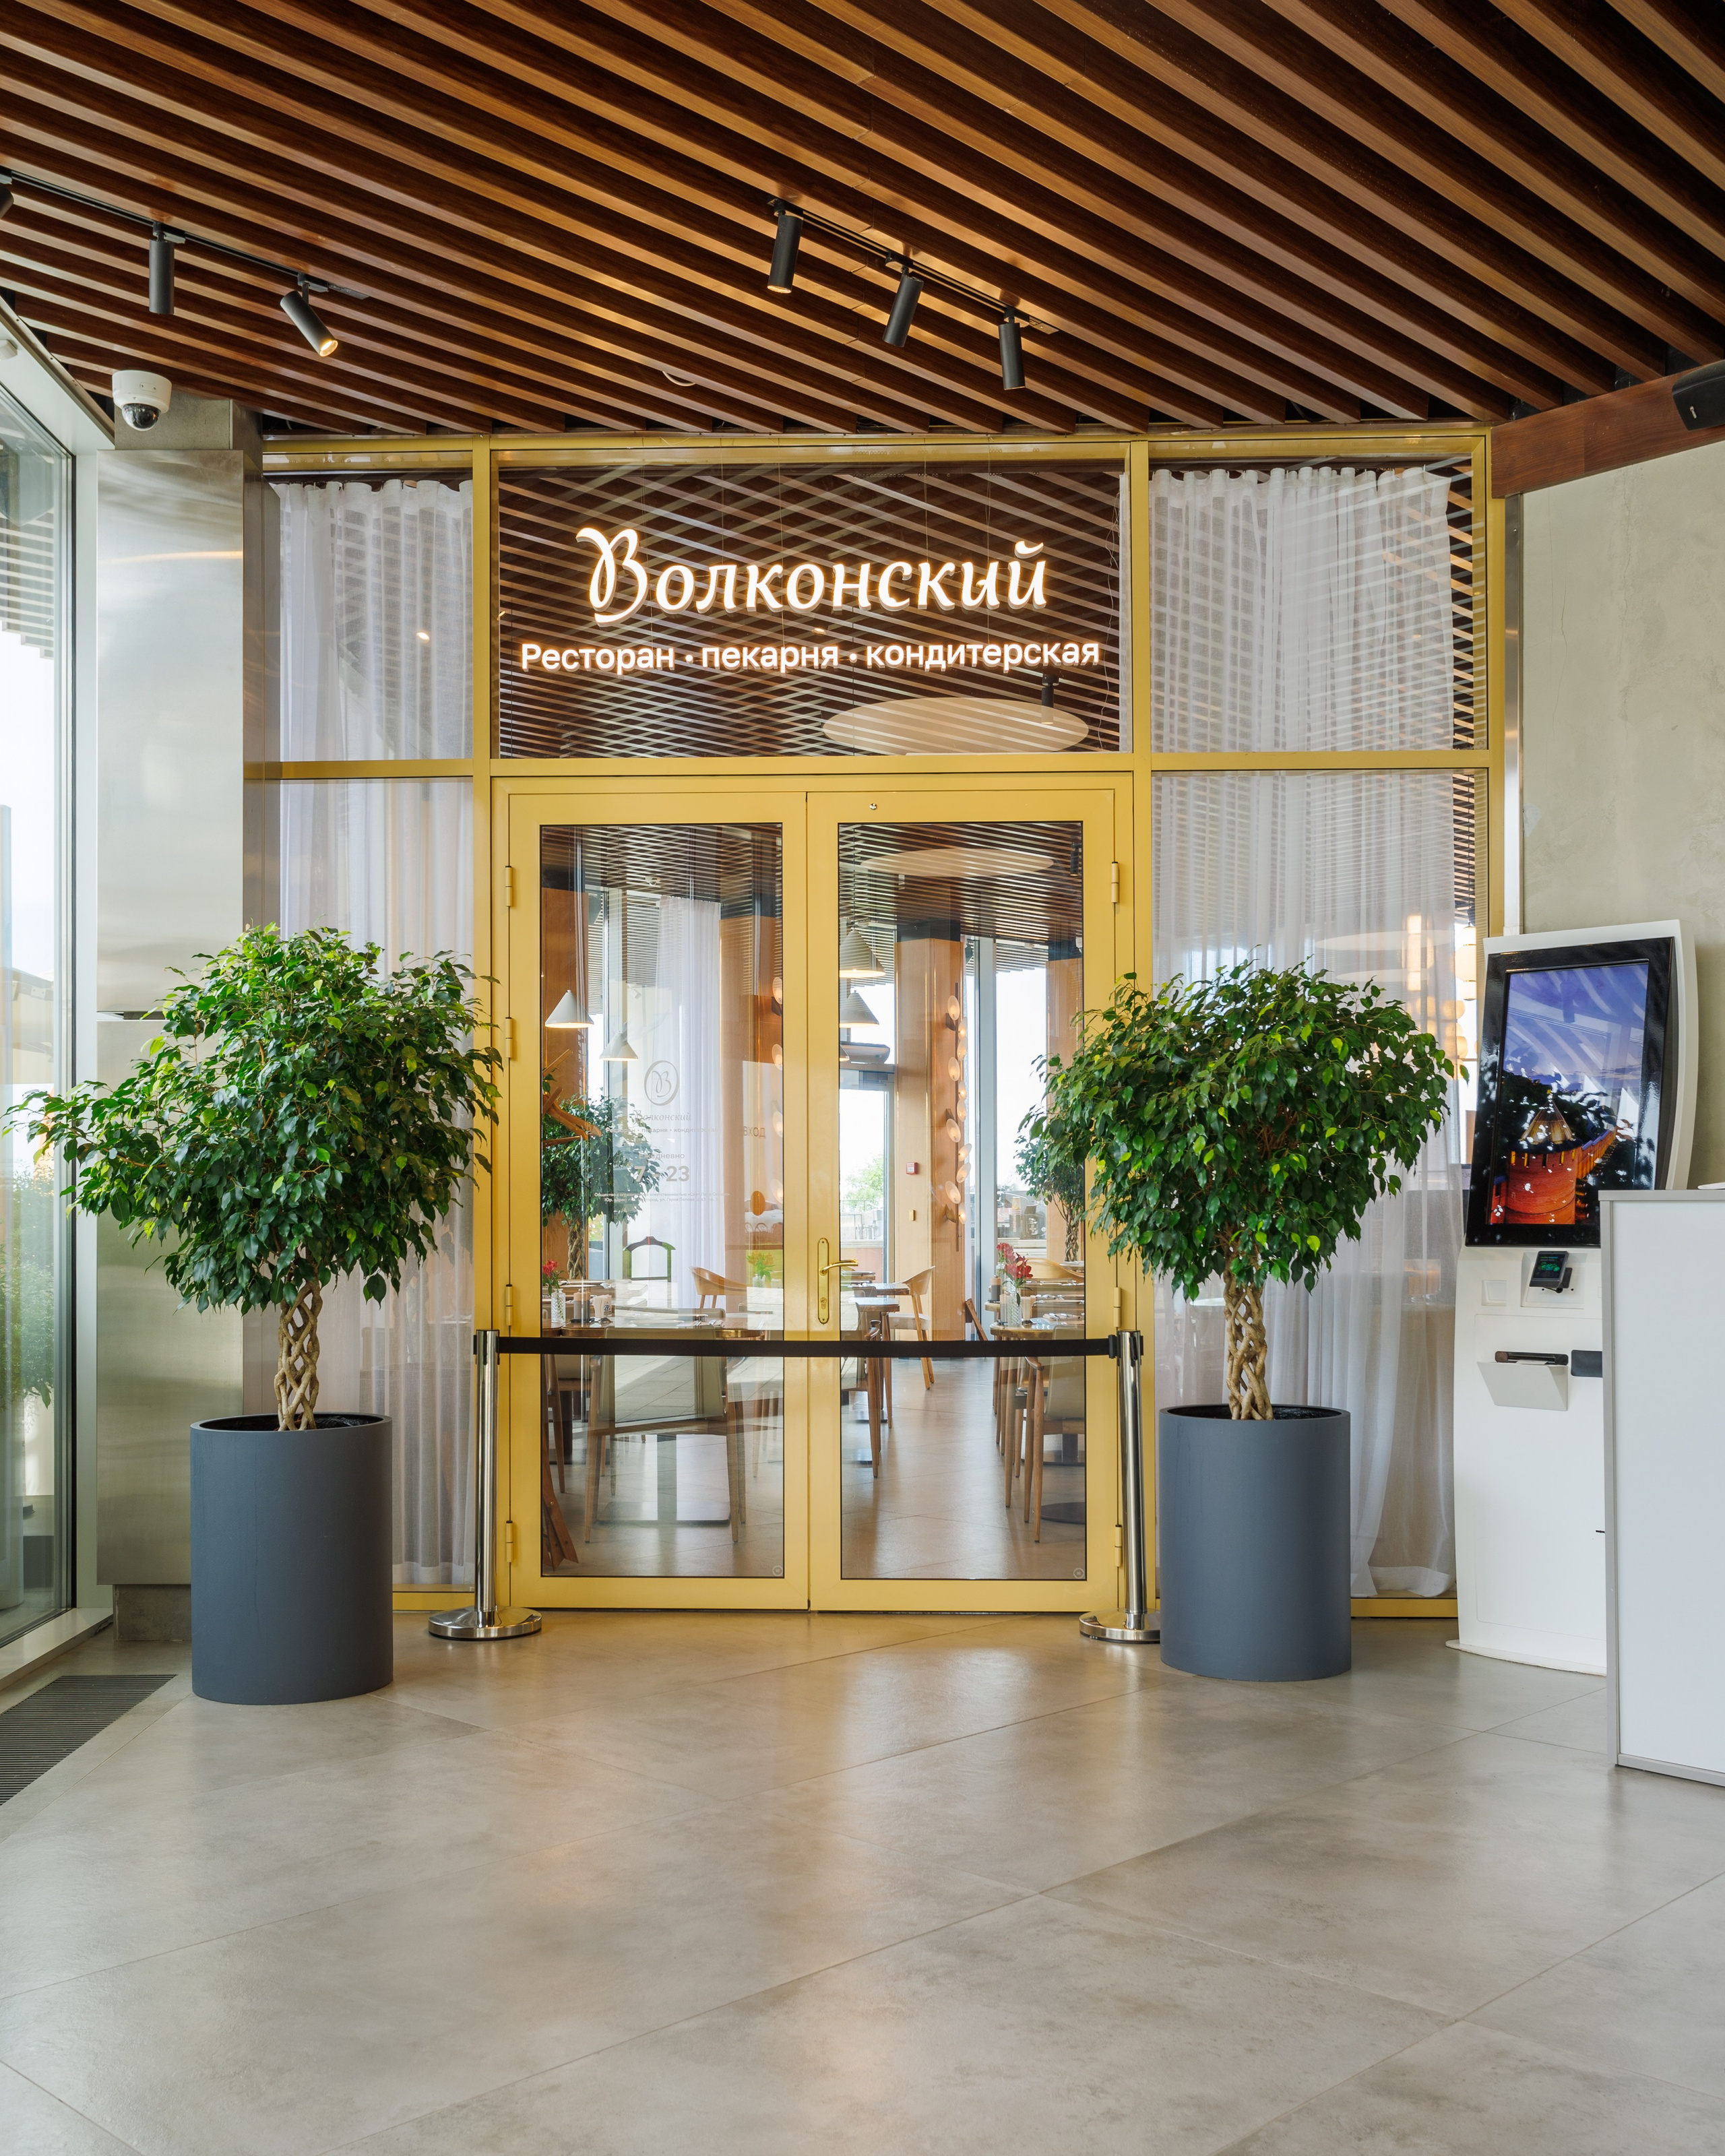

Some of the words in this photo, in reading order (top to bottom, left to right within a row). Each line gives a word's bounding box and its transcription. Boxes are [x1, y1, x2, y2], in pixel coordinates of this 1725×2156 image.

[575, 526, 1048, 626] Волконский
[520, 643, 675, 674] Ресторан
[701, 643, 839, 674] пекарня
[865, 639, 1100, 674] кондитерская
[743, 1126, 766, 1139] ВХОД
[634, 1166, 646, 1182] 7
[666, 1166, 690, 1182] 23
